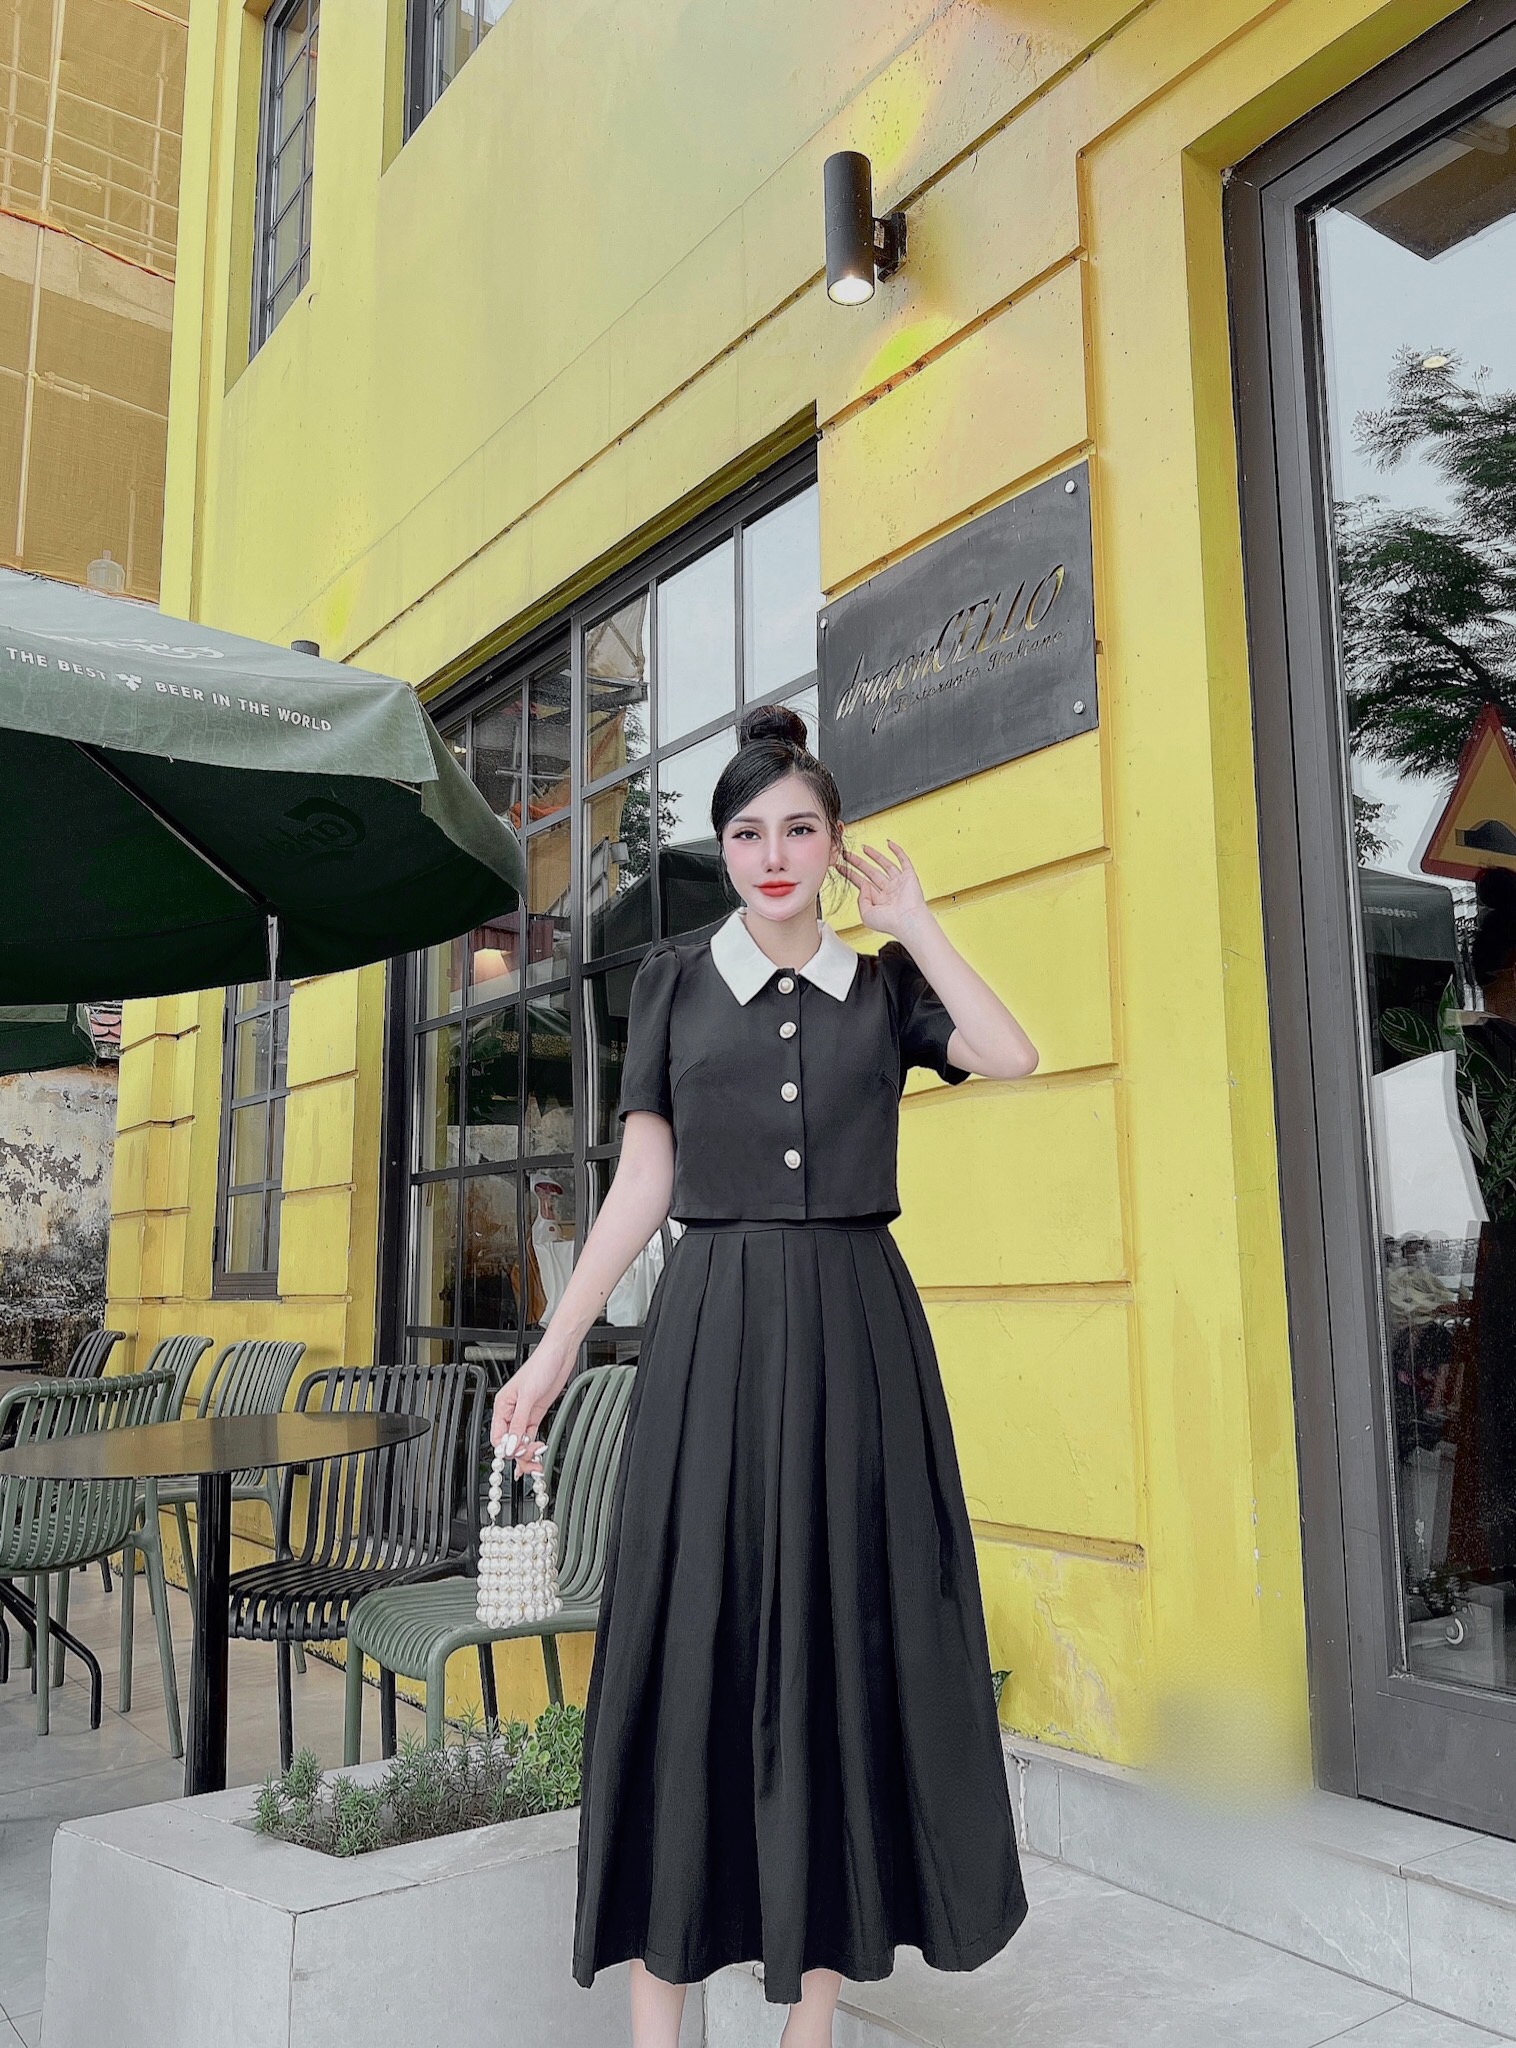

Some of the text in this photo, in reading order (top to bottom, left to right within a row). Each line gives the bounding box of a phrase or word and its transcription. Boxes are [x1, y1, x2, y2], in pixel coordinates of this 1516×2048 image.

[5, 646, 49, 668] THE
[57, 659, 107, 681] BEST
[154, 681, 205, 701] BEER
[212, 692, 231, 708] IN
[237, 697, 271, 718] THE
[277, 707, 333, 732] WORLD
[893, 629, 1065, 715] Ristorante Italiano
